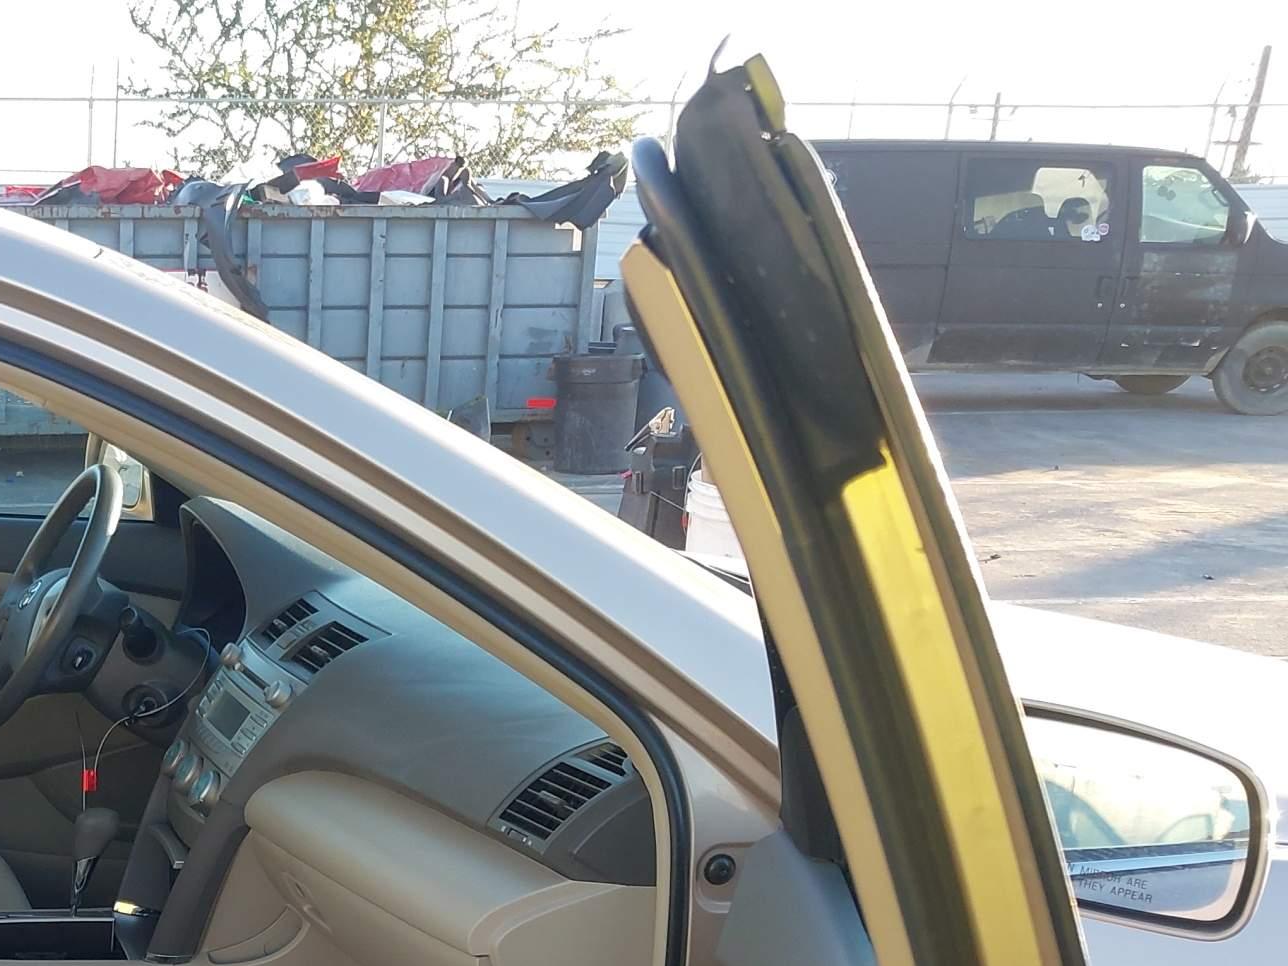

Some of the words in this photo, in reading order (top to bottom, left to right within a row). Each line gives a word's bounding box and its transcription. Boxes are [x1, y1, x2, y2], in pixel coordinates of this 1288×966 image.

[1078, 879, 1105, 892] THEY
[1110, 887, 1153, 904] APPEAR
[1126, 878, 1148, 890] ARE
